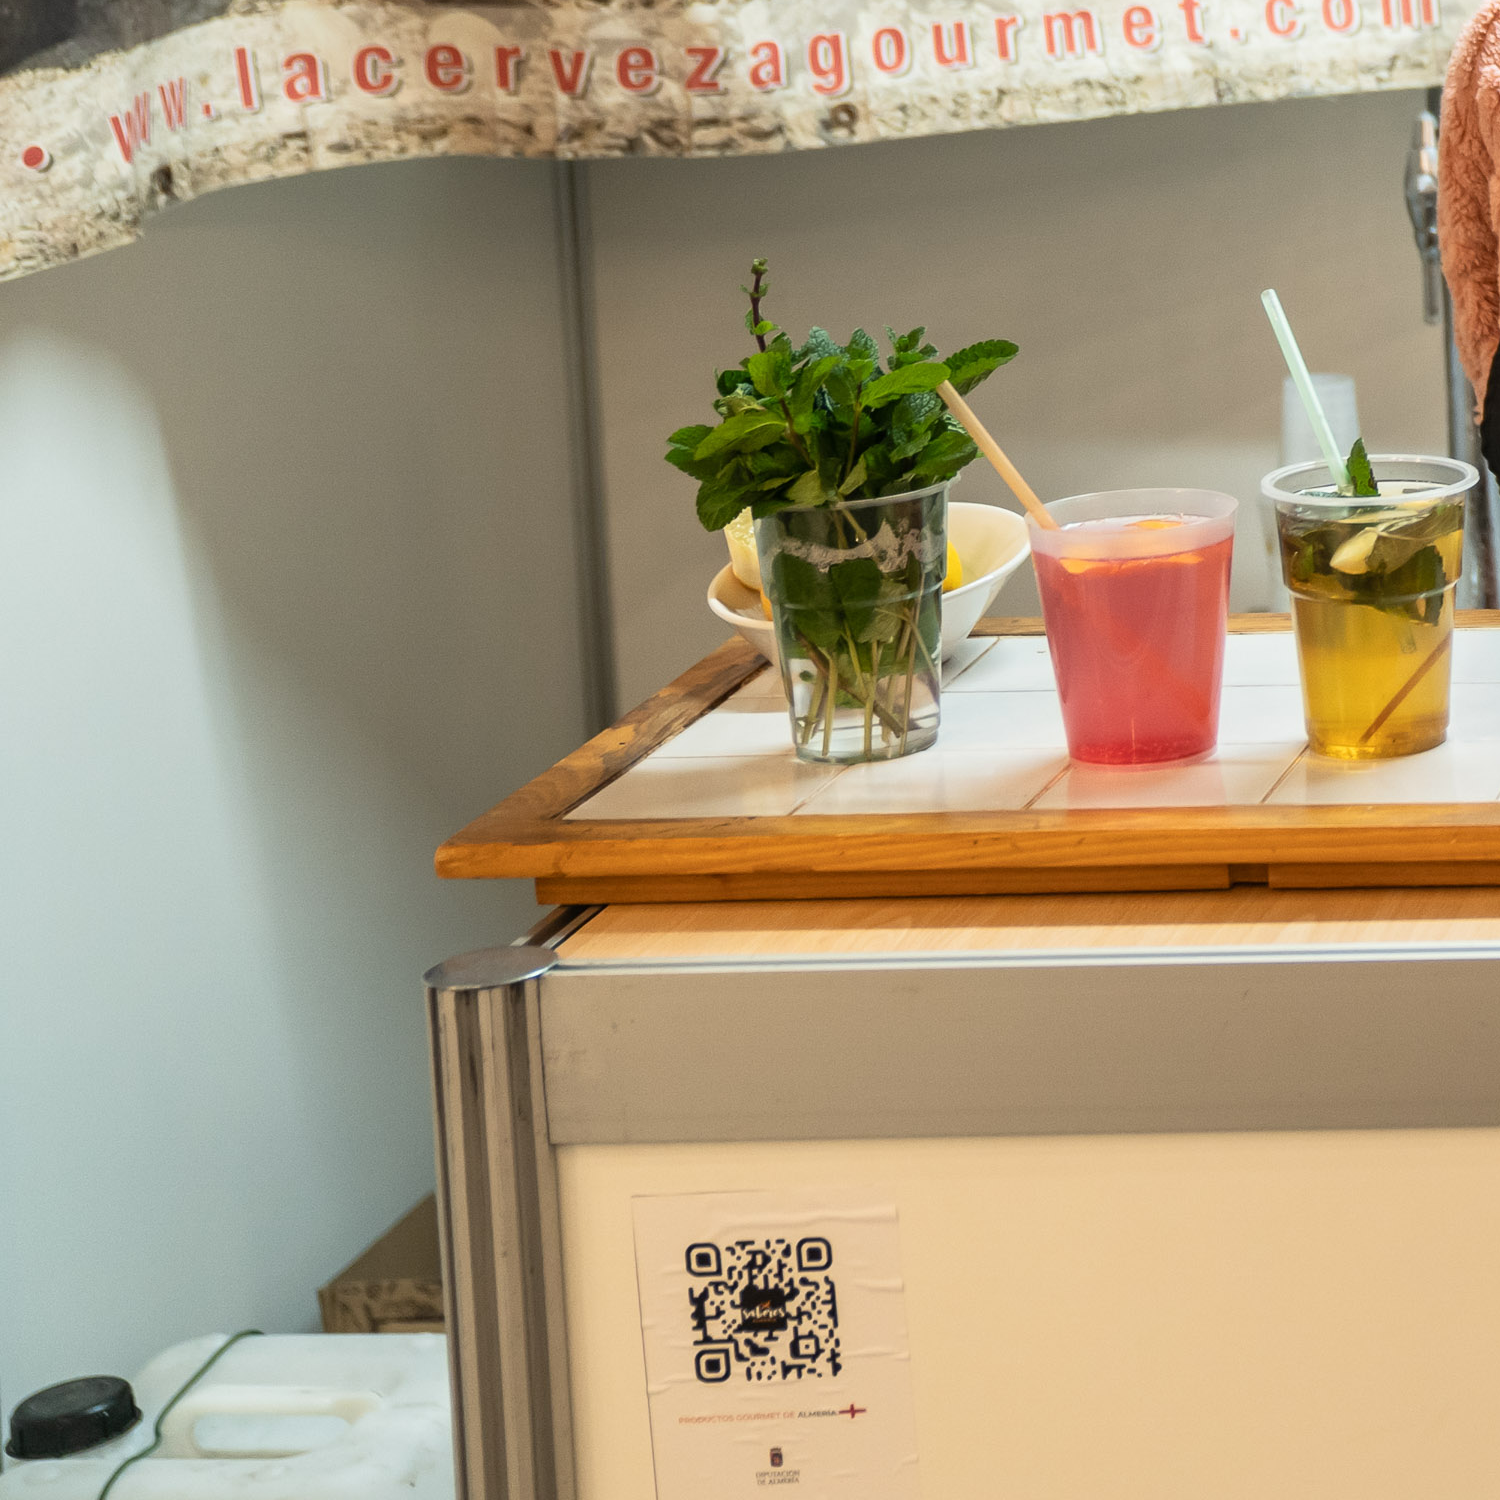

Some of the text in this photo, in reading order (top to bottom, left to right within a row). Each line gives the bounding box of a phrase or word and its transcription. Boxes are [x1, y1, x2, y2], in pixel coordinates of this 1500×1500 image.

[678, 1414, 736, 1425] PRODUCTOS
[736, 1411, 781, 1422] GOURMET
[783, 1411, 796, 1420] DE
